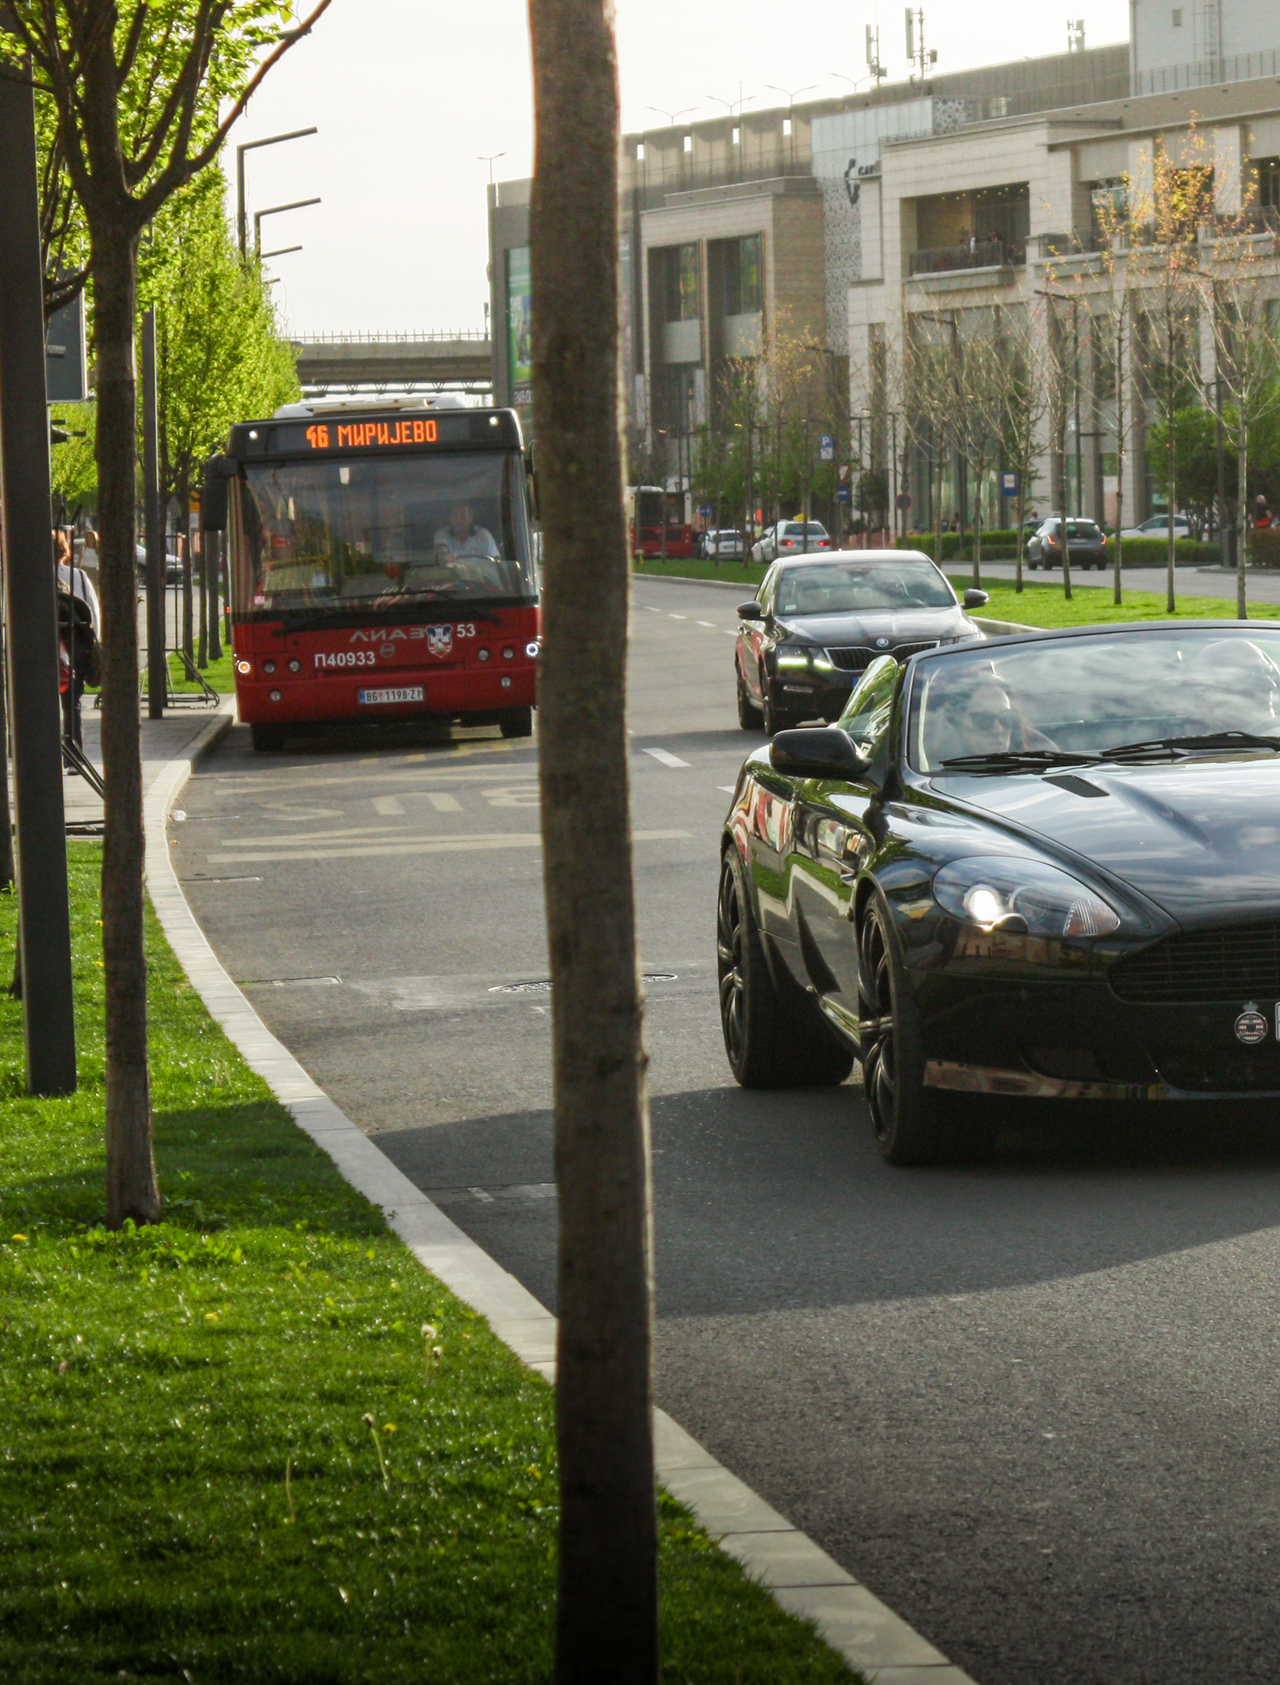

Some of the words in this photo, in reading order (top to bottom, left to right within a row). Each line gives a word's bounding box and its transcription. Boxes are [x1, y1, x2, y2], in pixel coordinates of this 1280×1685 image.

[306, 425, 330, 448] 46
[337, 420, 438, 447] МИРИЈЕВО
[457, 624, 476, 638] 53
[314, 651, 376, 667] П40933
[366, 691, 378, 702] BG
